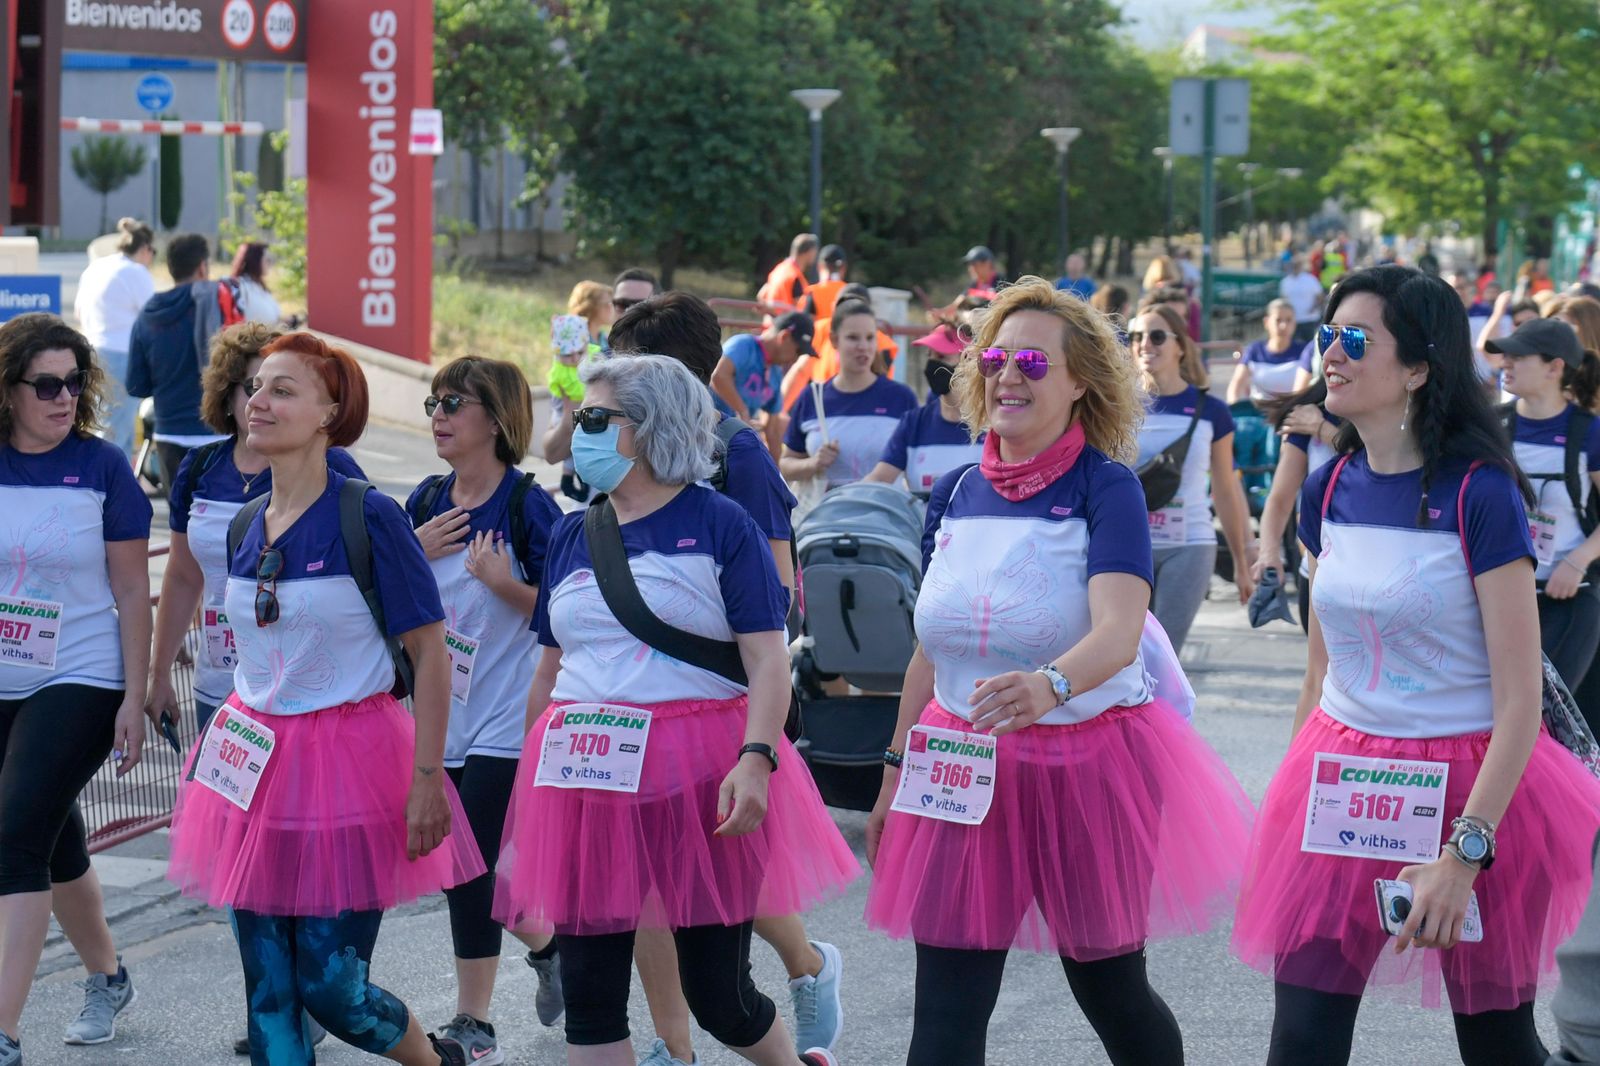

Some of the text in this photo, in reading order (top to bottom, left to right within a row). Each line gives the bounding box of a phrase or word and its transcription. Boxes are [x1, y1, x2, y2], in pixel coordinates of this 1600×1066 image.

[65, 0, 202, 32] Bienvenidos
[229, 9, 250, 32] 20
[361, 10, 398, 327] Bienvenidos
[2, 648, 34, 660] vithas
[564, 712, 647, 730] COVIRAN
[606, 707, 649, 719] Fundación
[225, 718, 273, 752] COVIRAN
[569, 733, 611, 757] 7470
[219, 738, 250, 771] 5207
[927, 737, 995, 760] COVIRAN
[575, 766, 612, 780] vithas
[930, 760, 973, 790] 5166
[1340, 767, 1443, 789] COVIRAN
[1396, 763, 1445, 775] Fundación
[220, 775, 240, 794] vithas
[935, 798, 968, 814] vithas
[1348, 792, 1406, 822] 5167
[1359, 833, 1407, 850] vithas
